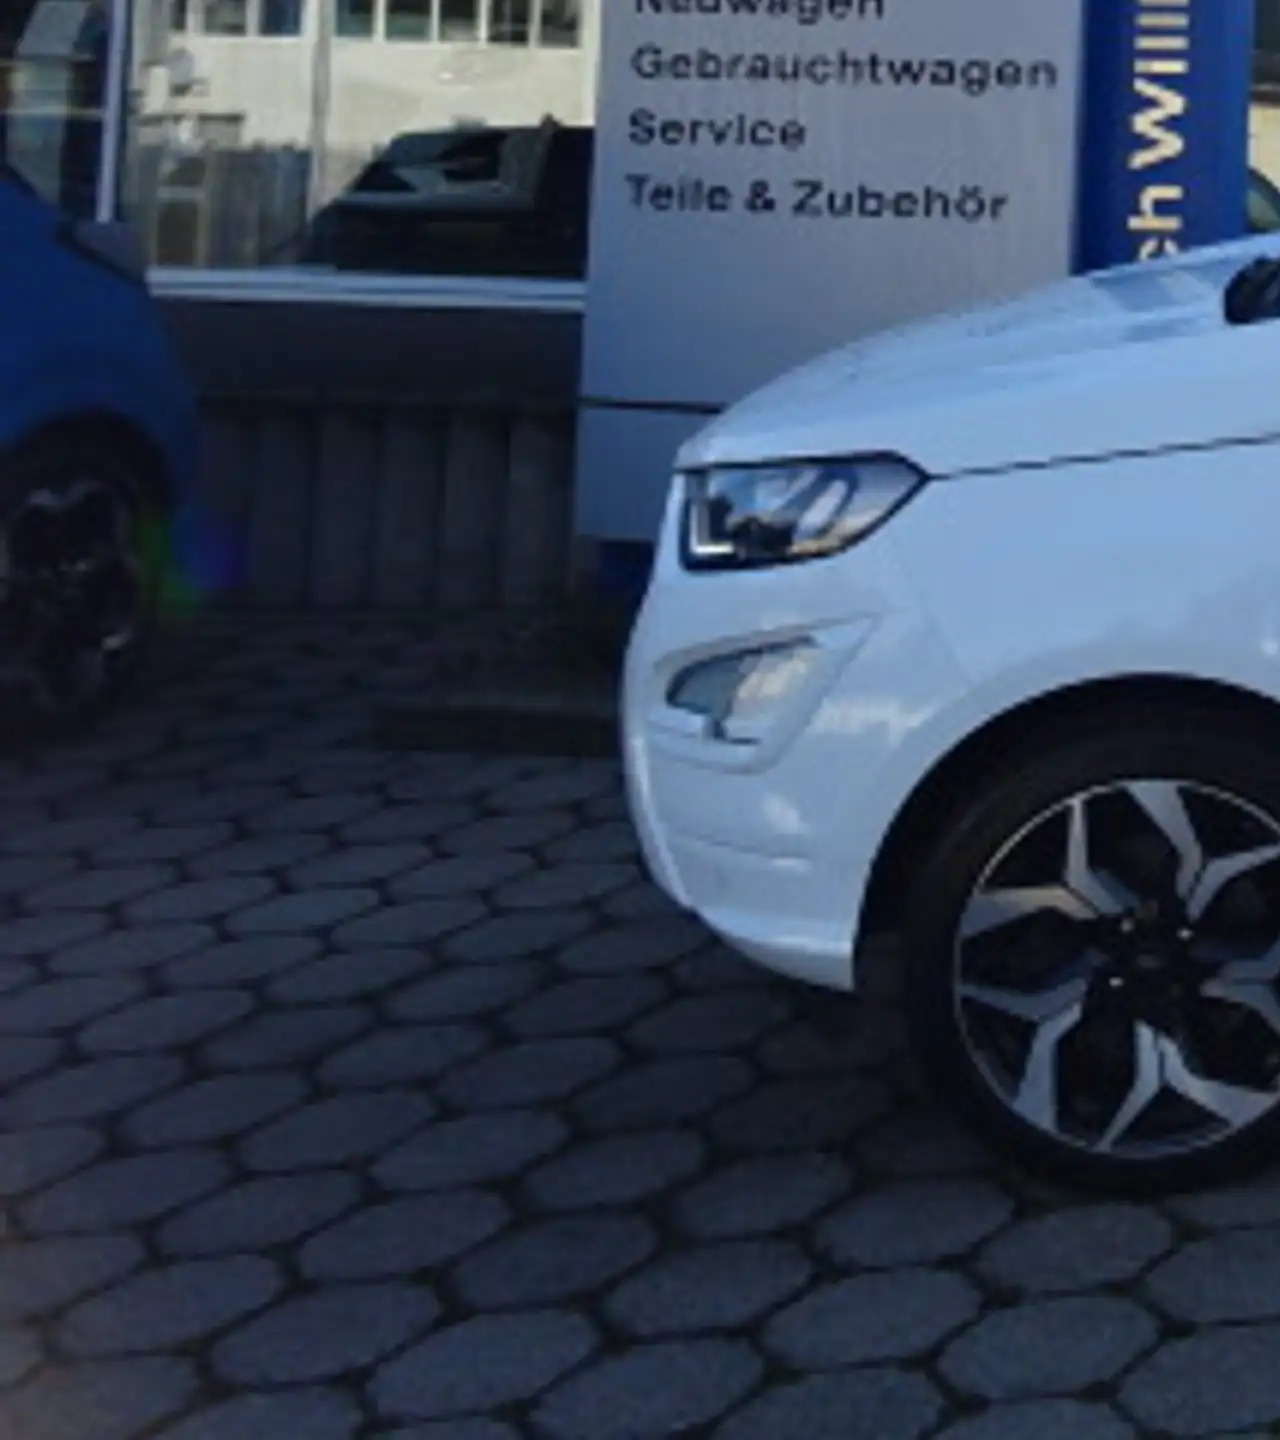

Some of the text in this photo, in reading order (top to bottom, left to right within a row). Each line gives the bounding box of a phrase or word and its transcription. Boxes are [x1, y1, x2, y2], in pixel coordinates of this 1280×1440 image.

[632, 46, 1059, 95] Gebrauchtwagen
[627, 110, 807, 149] Service
[626, 173, 1009, 220] Teile & Zubehör
